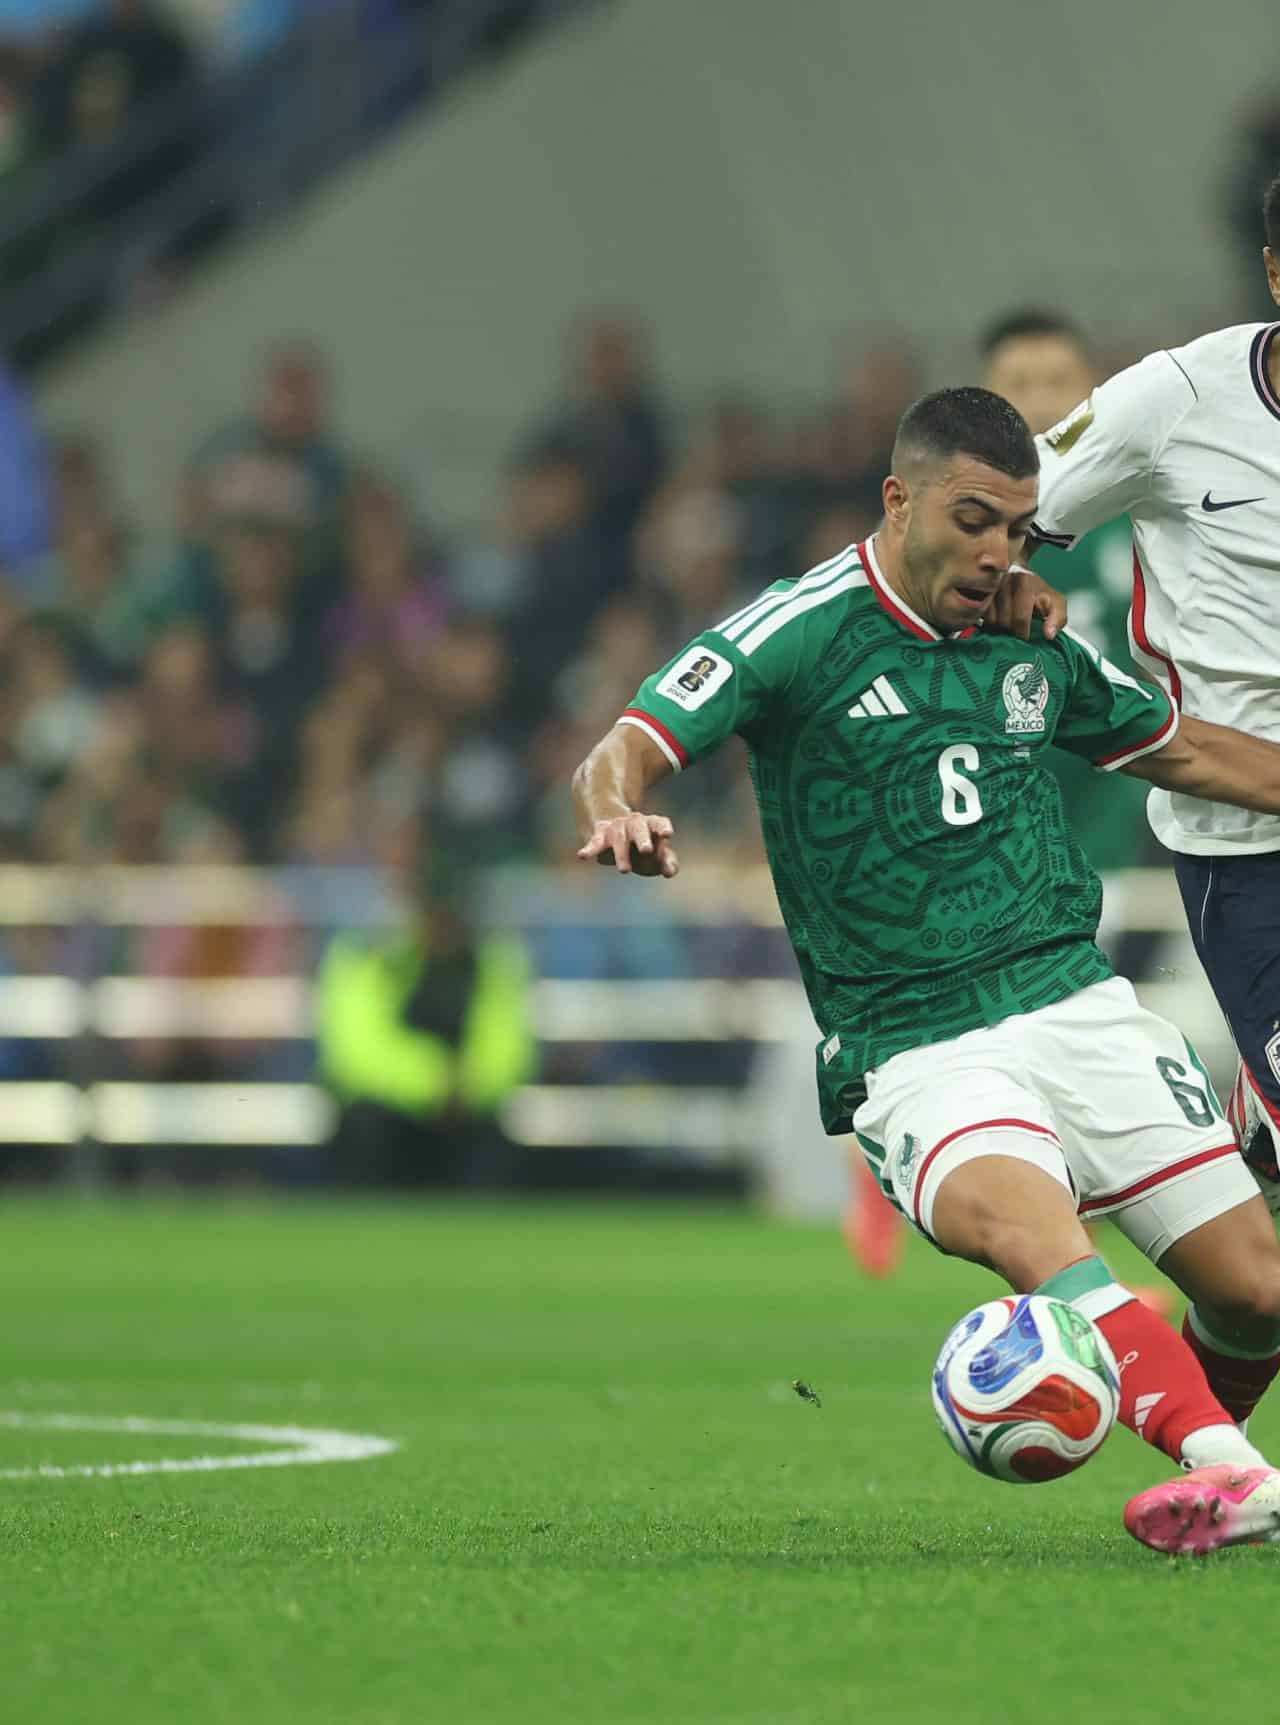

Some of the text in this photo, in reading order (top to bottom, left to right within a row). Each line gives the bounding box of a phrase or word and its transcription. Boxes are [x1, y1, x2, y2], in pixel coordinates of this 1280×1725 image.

[1007, 720, 1043, 731] MEXICO
[938, 743, 983, 826] 6
[1155, 1055, 1215, 1128] 6
